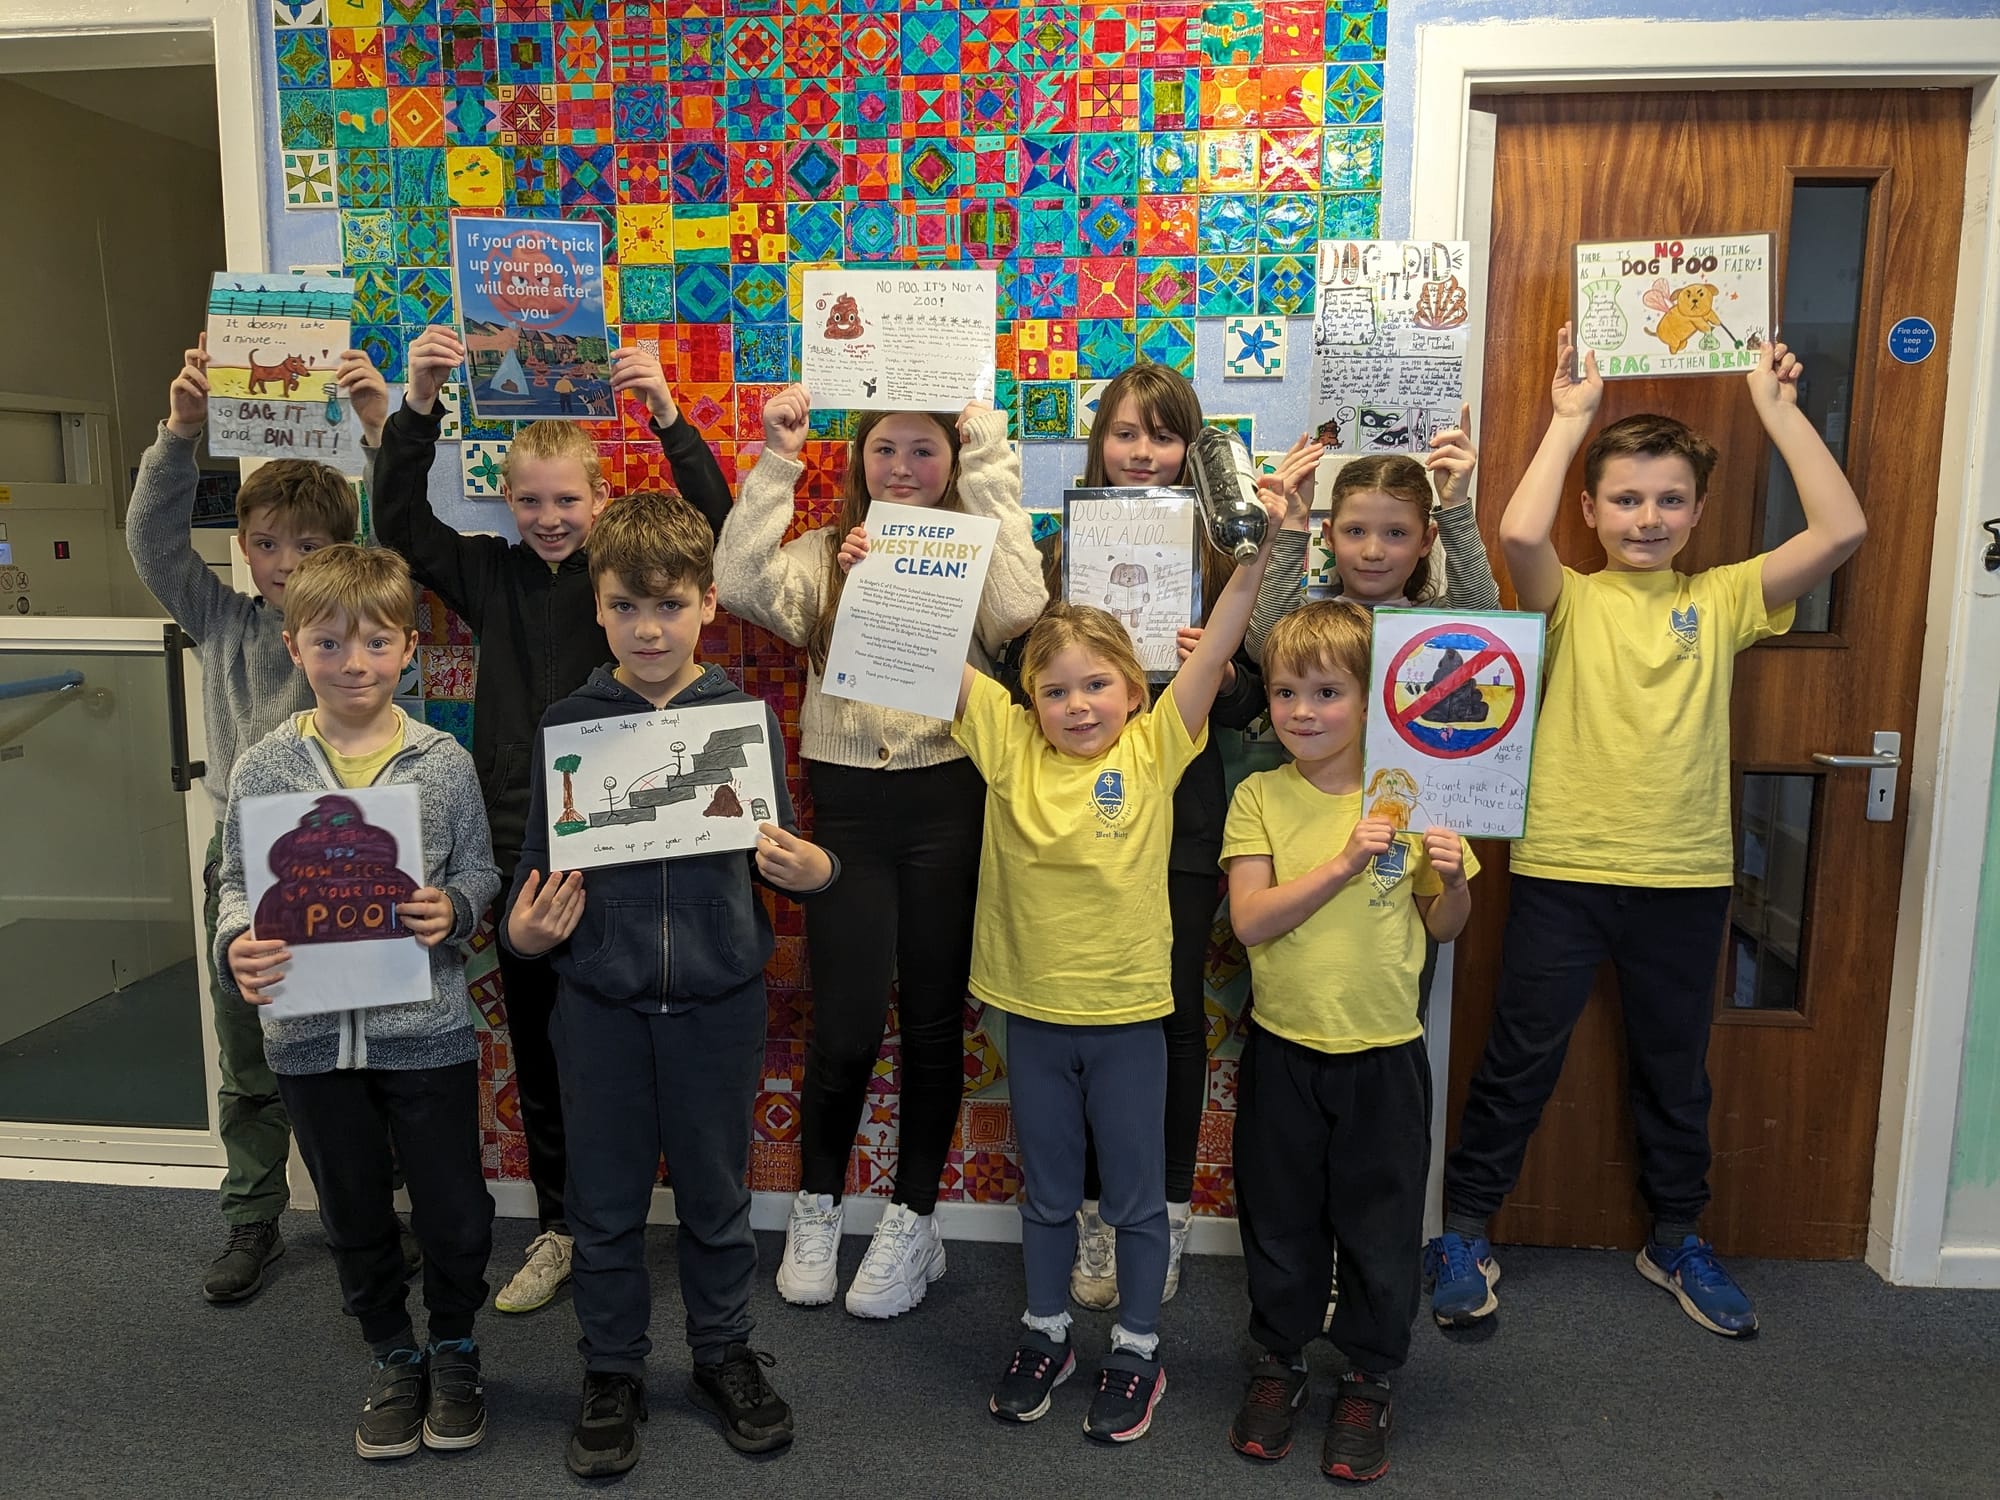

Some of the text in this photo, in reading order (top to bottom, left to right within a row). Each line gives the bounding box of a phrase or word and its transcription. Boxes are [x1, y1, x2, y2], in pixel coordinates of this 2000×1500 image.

[468, 234, 594, 254] If you don't pick
[1580, 241, 1750, 262] THERE IS NO SUCH THING
[470, 260, 594, 277] up your poo, we
[1580, 256, 1762, 279] AS A DOG POO FAIRY!
[475, 281, 592, 298] will come after
[876, 280, 892, 293] NO
[923, 282, 947, 292] IT'S
[975, 284, 984, 293] A
[913, 296, 944, 308] ZOO!
[226, 318, 238, 328] It
[520, 308, 550, 322] you
[1903, 337, 1921, 345] keep
[1610, 354, 1650, 375] BAG
[1709, 352, 1750, 369] BIN
[239, 402, 276, 421] BAG
[285, 405, 306, 424] IT
[222, 429, 250, 441] and
[264, 428, 293, 447] BIN
[882, 524, 955, 539] LET'S KEEP
[1072, 525, 1112, 546] HAVE
[1119, 526, 1129, 545] A
[870, 538, 982, 561] WEST KIRBY
[894, 558, 968, 579] CLEAN!
[619, 719, 638, 733] skip
[1494, 752, 1511, 763] Age
[1425, 776, 1433, 787] I
[1469, 782, 1488, 796] pick
[1494, 783, 1507, 793] it
[1509, 788, 1525, 800] up
[1442, 794, 1470, 808] you
[1434, 813, 1506, 834] Thank you
[625, 843, 634, 852] up
[318, 885, 362, 899] YOUR
